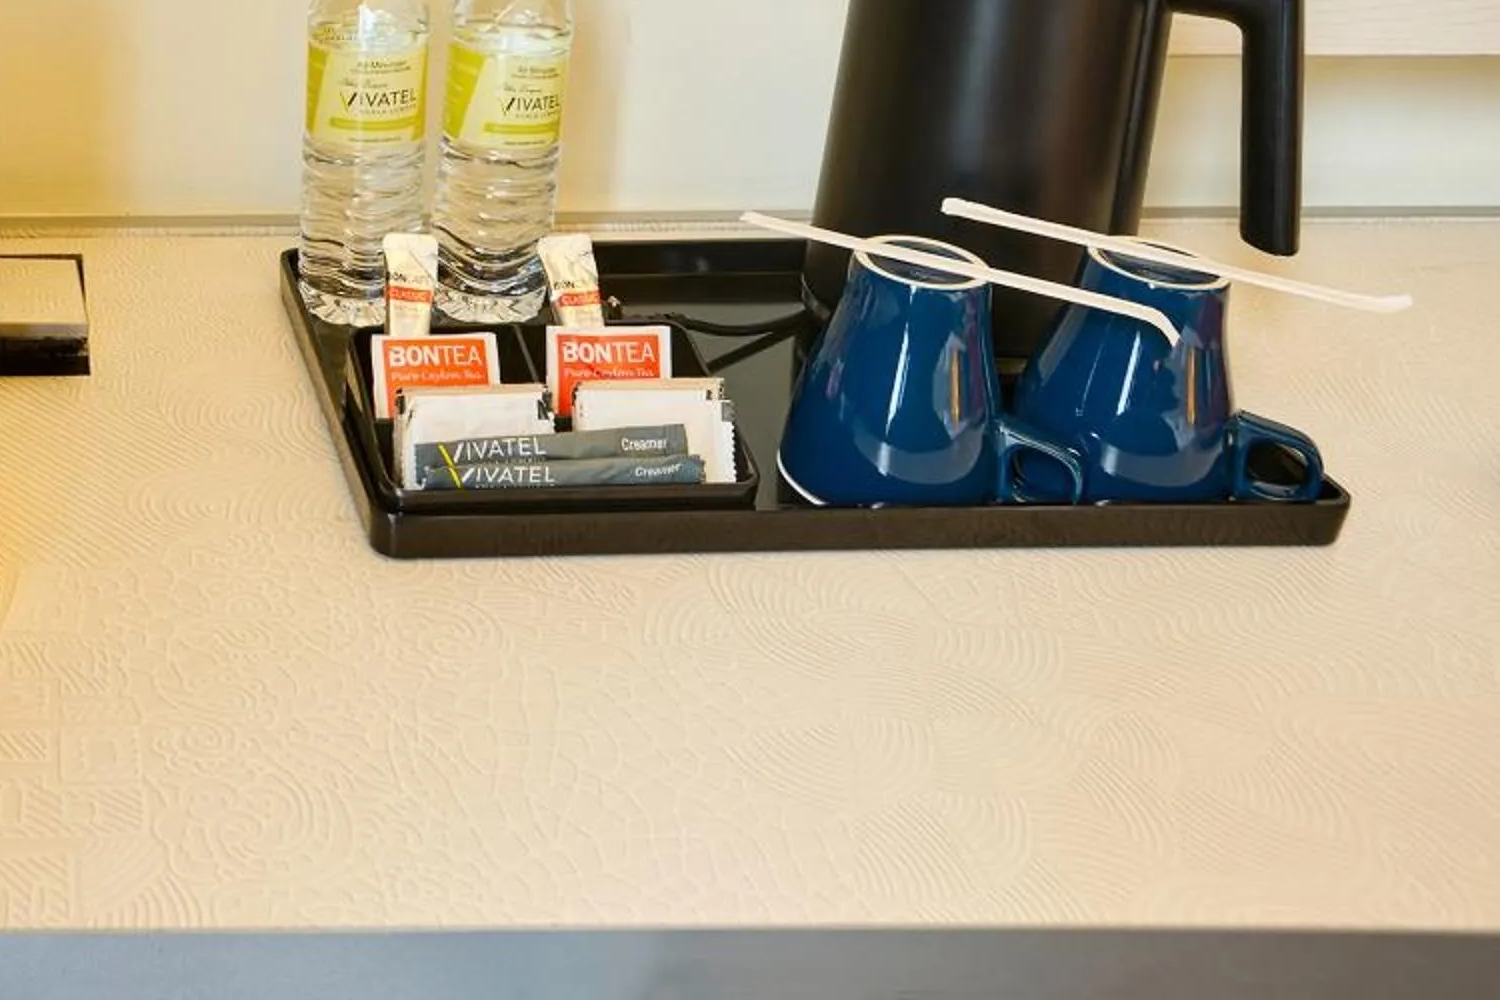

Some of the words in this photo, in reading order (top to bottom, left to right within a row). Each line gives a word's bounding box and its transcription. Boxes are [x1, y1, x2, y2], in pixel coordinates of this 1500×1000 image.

[340, 89, 417, 112] VIVATEL
[388, 345, 483, 367] BONTEA
[563, 341, 655, 363] BONTEA
[437, 437, 548, 468] VIVATEL
[621, 438, 668, 451] Creamer
[449, 464, 555, 488] VIVATEL
[635, 463, 684, 477] Creamer
